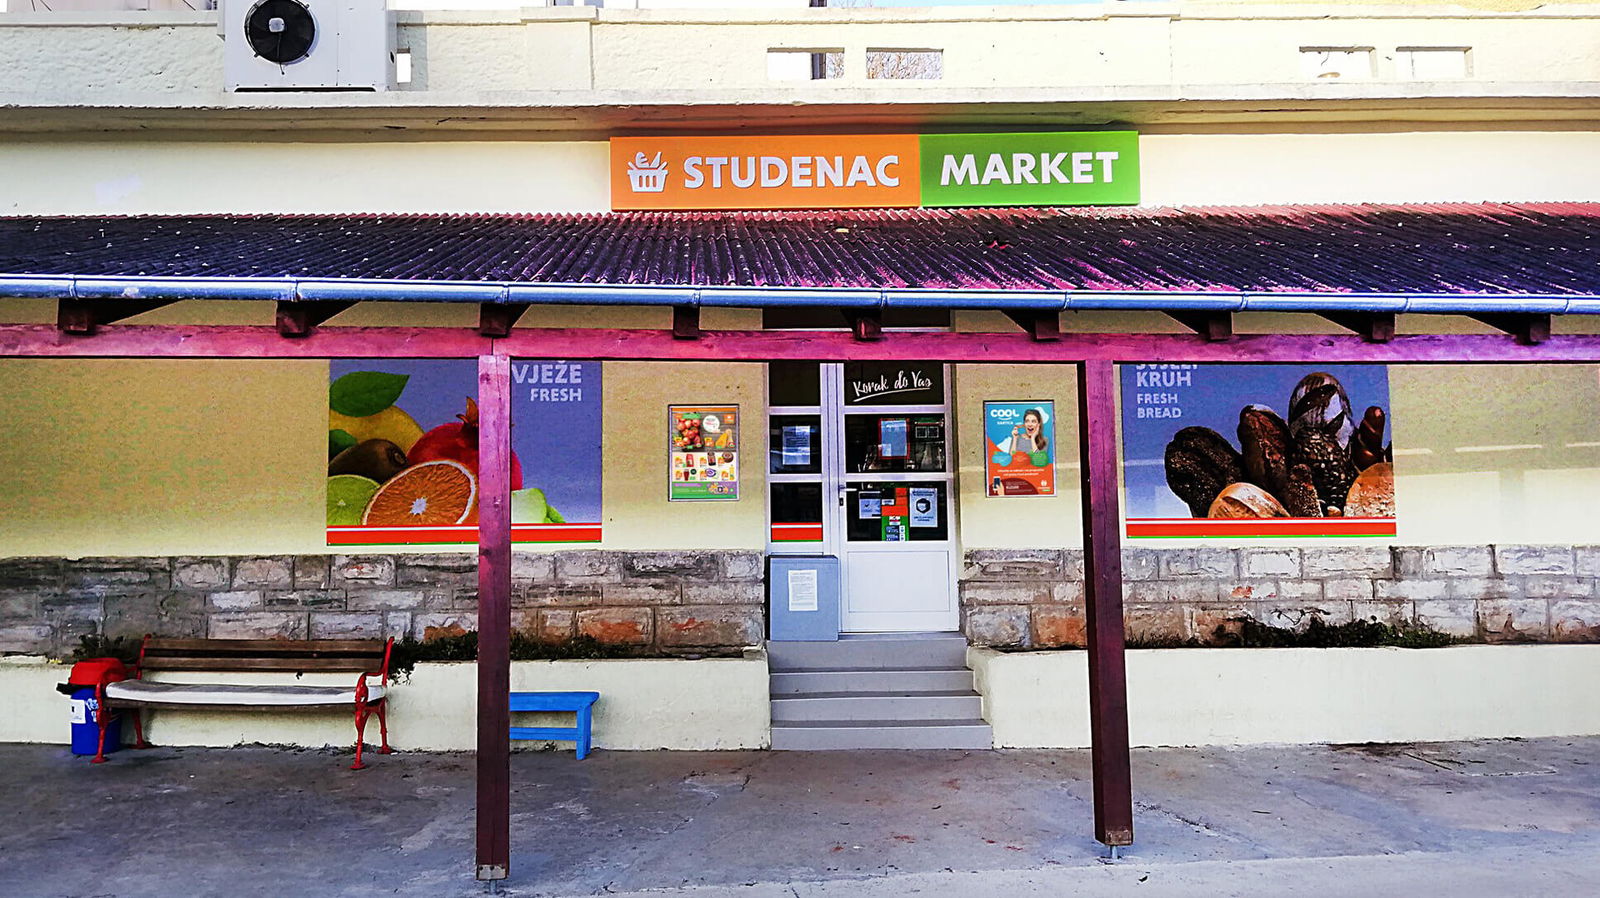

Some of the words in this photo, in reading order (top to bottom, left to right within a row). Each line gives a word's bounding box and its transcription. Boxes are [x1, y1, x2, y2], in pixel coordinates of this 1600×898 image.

[683, 155, 900, 189] STUDENAC
[940, 151, 1119, 186] MARKET
[852, 374, 889, 397] Korak
[894, 370, 909, 389] do
[911, 370, 933, 388] Vas
[1136, 371, 1192, 387] KRUH
[530, 388, 582, 402] FRESH
[1136, 393, 1178, 404] FRESH
[990, 408, 1020, 418] COOL
[1137, 407, 1182, 419] BREAD
